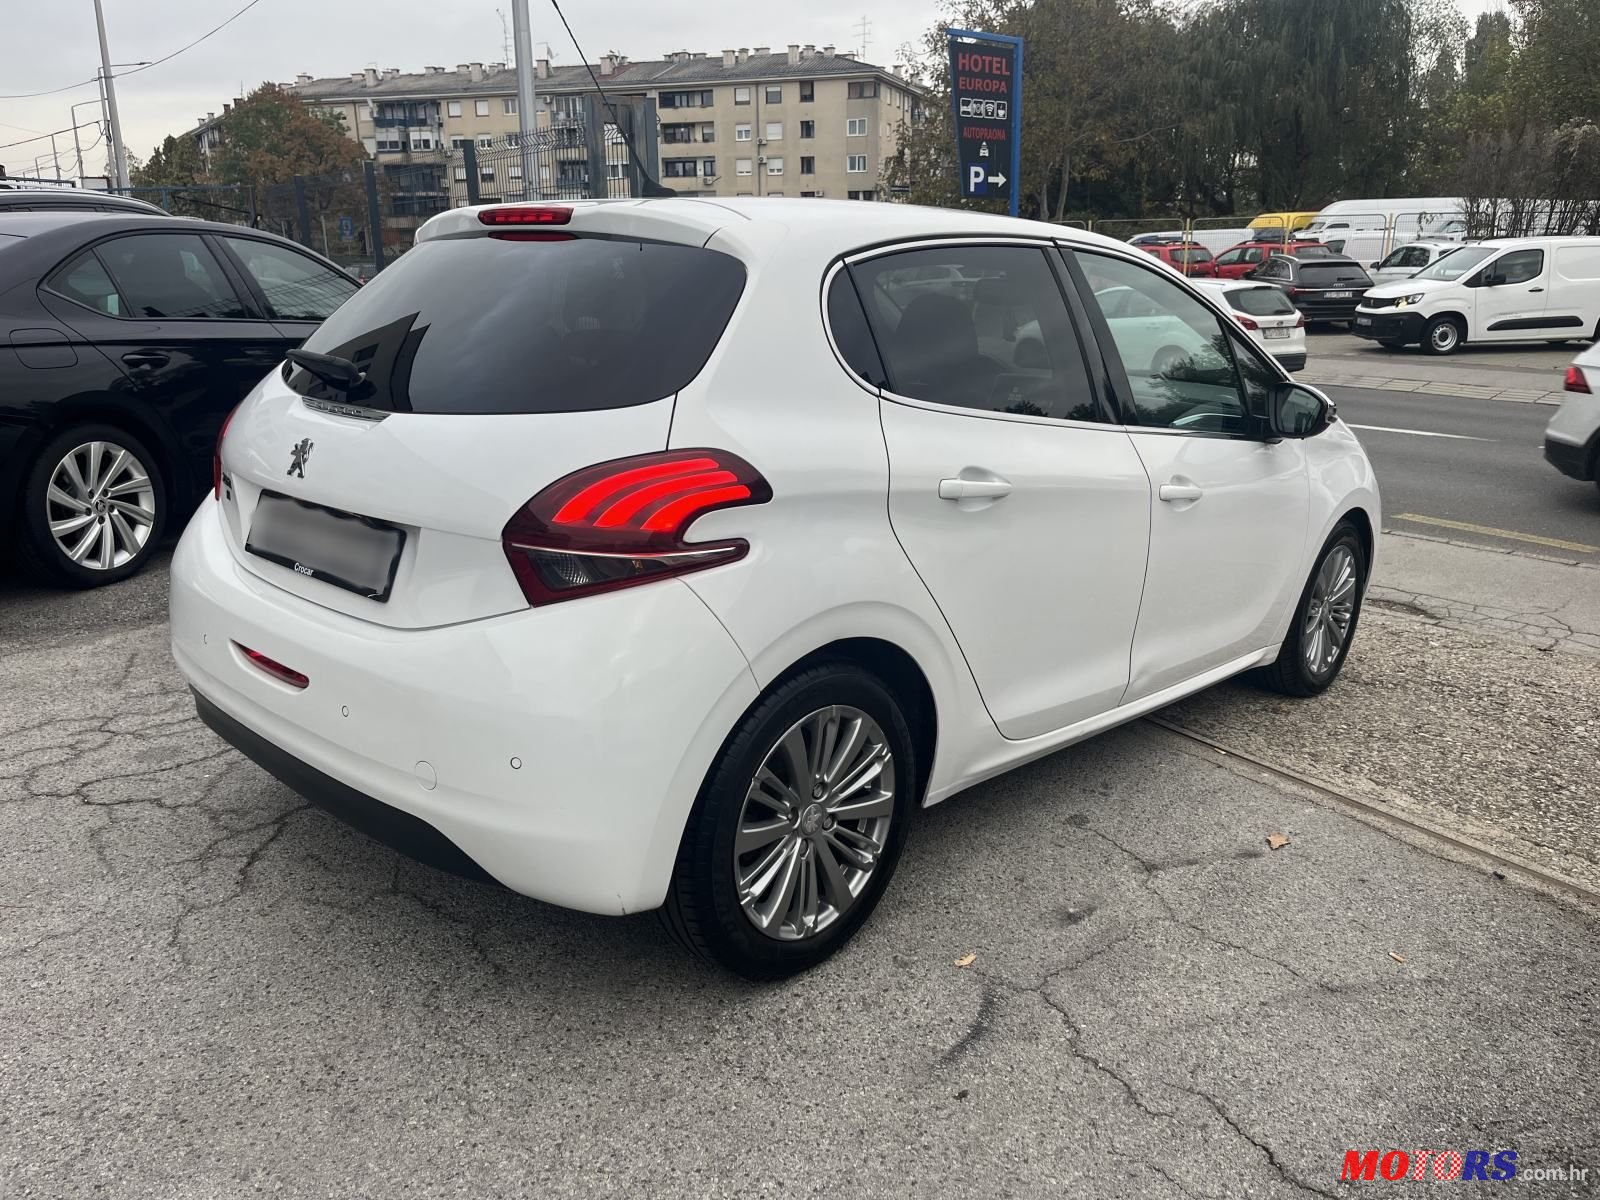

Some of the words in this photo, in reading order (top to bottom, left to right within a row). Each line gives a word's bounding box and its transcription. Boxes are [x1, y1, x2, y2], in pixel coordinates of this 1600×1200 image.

[958, 53, 1010, 75] HOTEL
[959, 77, 1008, 93] EUROPA
[970, 166, 985, 192] P
[295, 562, 314, 576] Crocar
